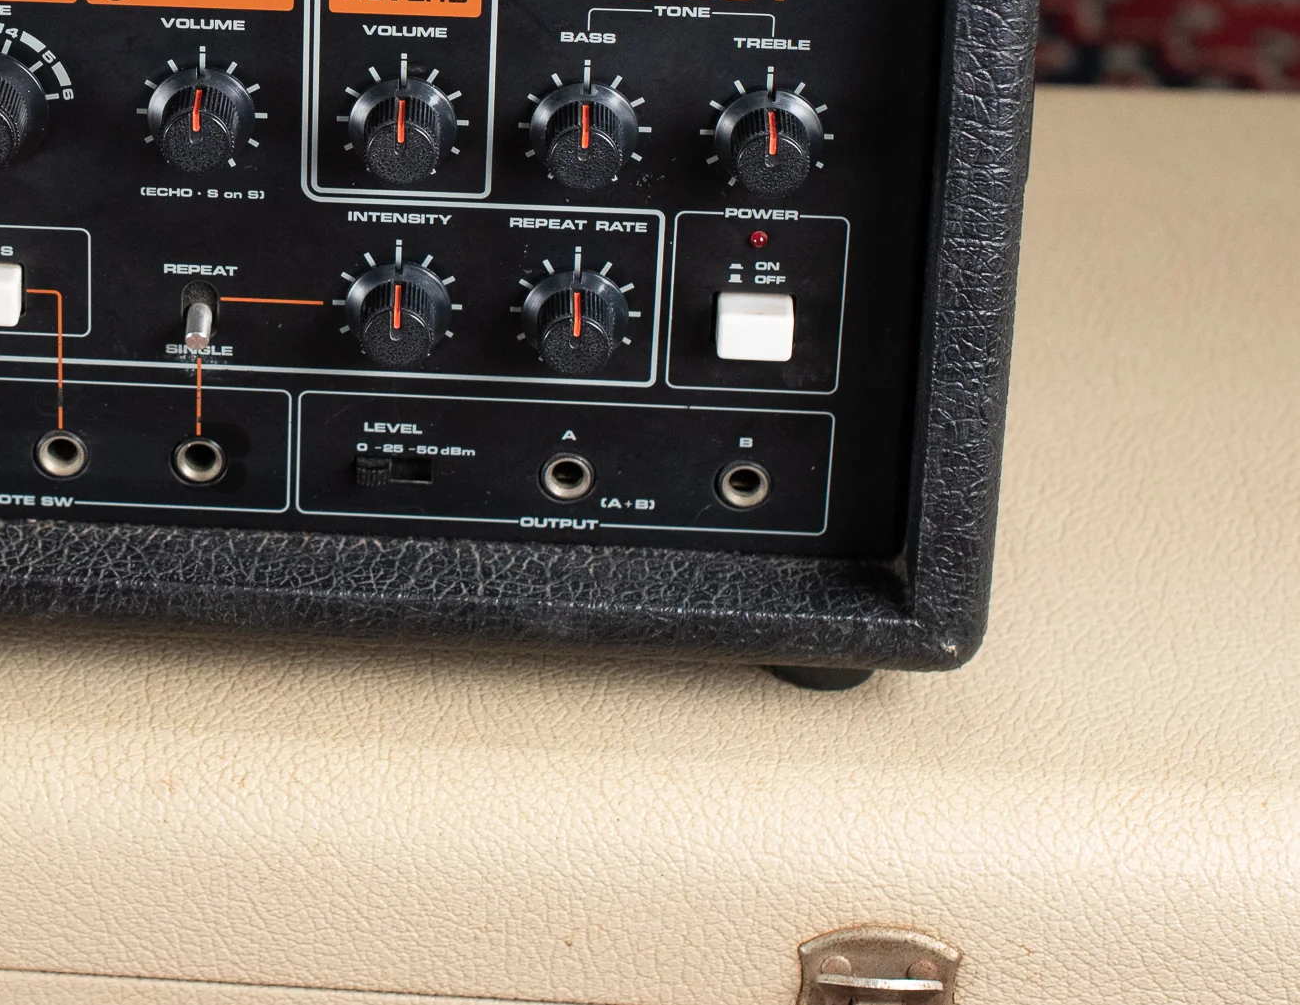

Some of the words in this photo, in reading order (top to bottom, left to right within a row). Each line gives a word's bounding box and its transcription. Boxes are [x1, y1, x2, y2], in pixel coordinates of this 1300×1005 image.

[654, 5, 711, 18] TONE
[160, 17, 246, 31] VOLUME
[362, 24, 448, 38] VOLUME
[560, 31, 616, 44] BASS
[734, 37, 811, 51] TREBLE
[5, 27, 19, 39] 4
[41, 49, 57, 64] 5
[62, 88, 75, 101] 6
[223, 191, 243, 200] on
[347, 210, 452, 226] INTENSITY
[724, 207, 799, 221] POWER
[509, 216, 588, 231] REPEAT
[595, 219, 648, 233] RATE
[0, 245, 14, 257] S
[163, 263, 238, 276] REPEAT
[755, 261, 780, 271] ON
[754, 275, 786, 285] OFF
[165, 343, 234, 357] SINGLE
[363, 421, 423, 435] LEVEL
[561, 429, 577, 442] A
[374, 443, 403, 454] -25
[408, 445, 438, 456] -50
[440, 446, 476, 457] dBm
[739, 437, 754, 449] B
[40, 494, 74, 508] SW
[519, 516, 599, 531] OUTPUT
